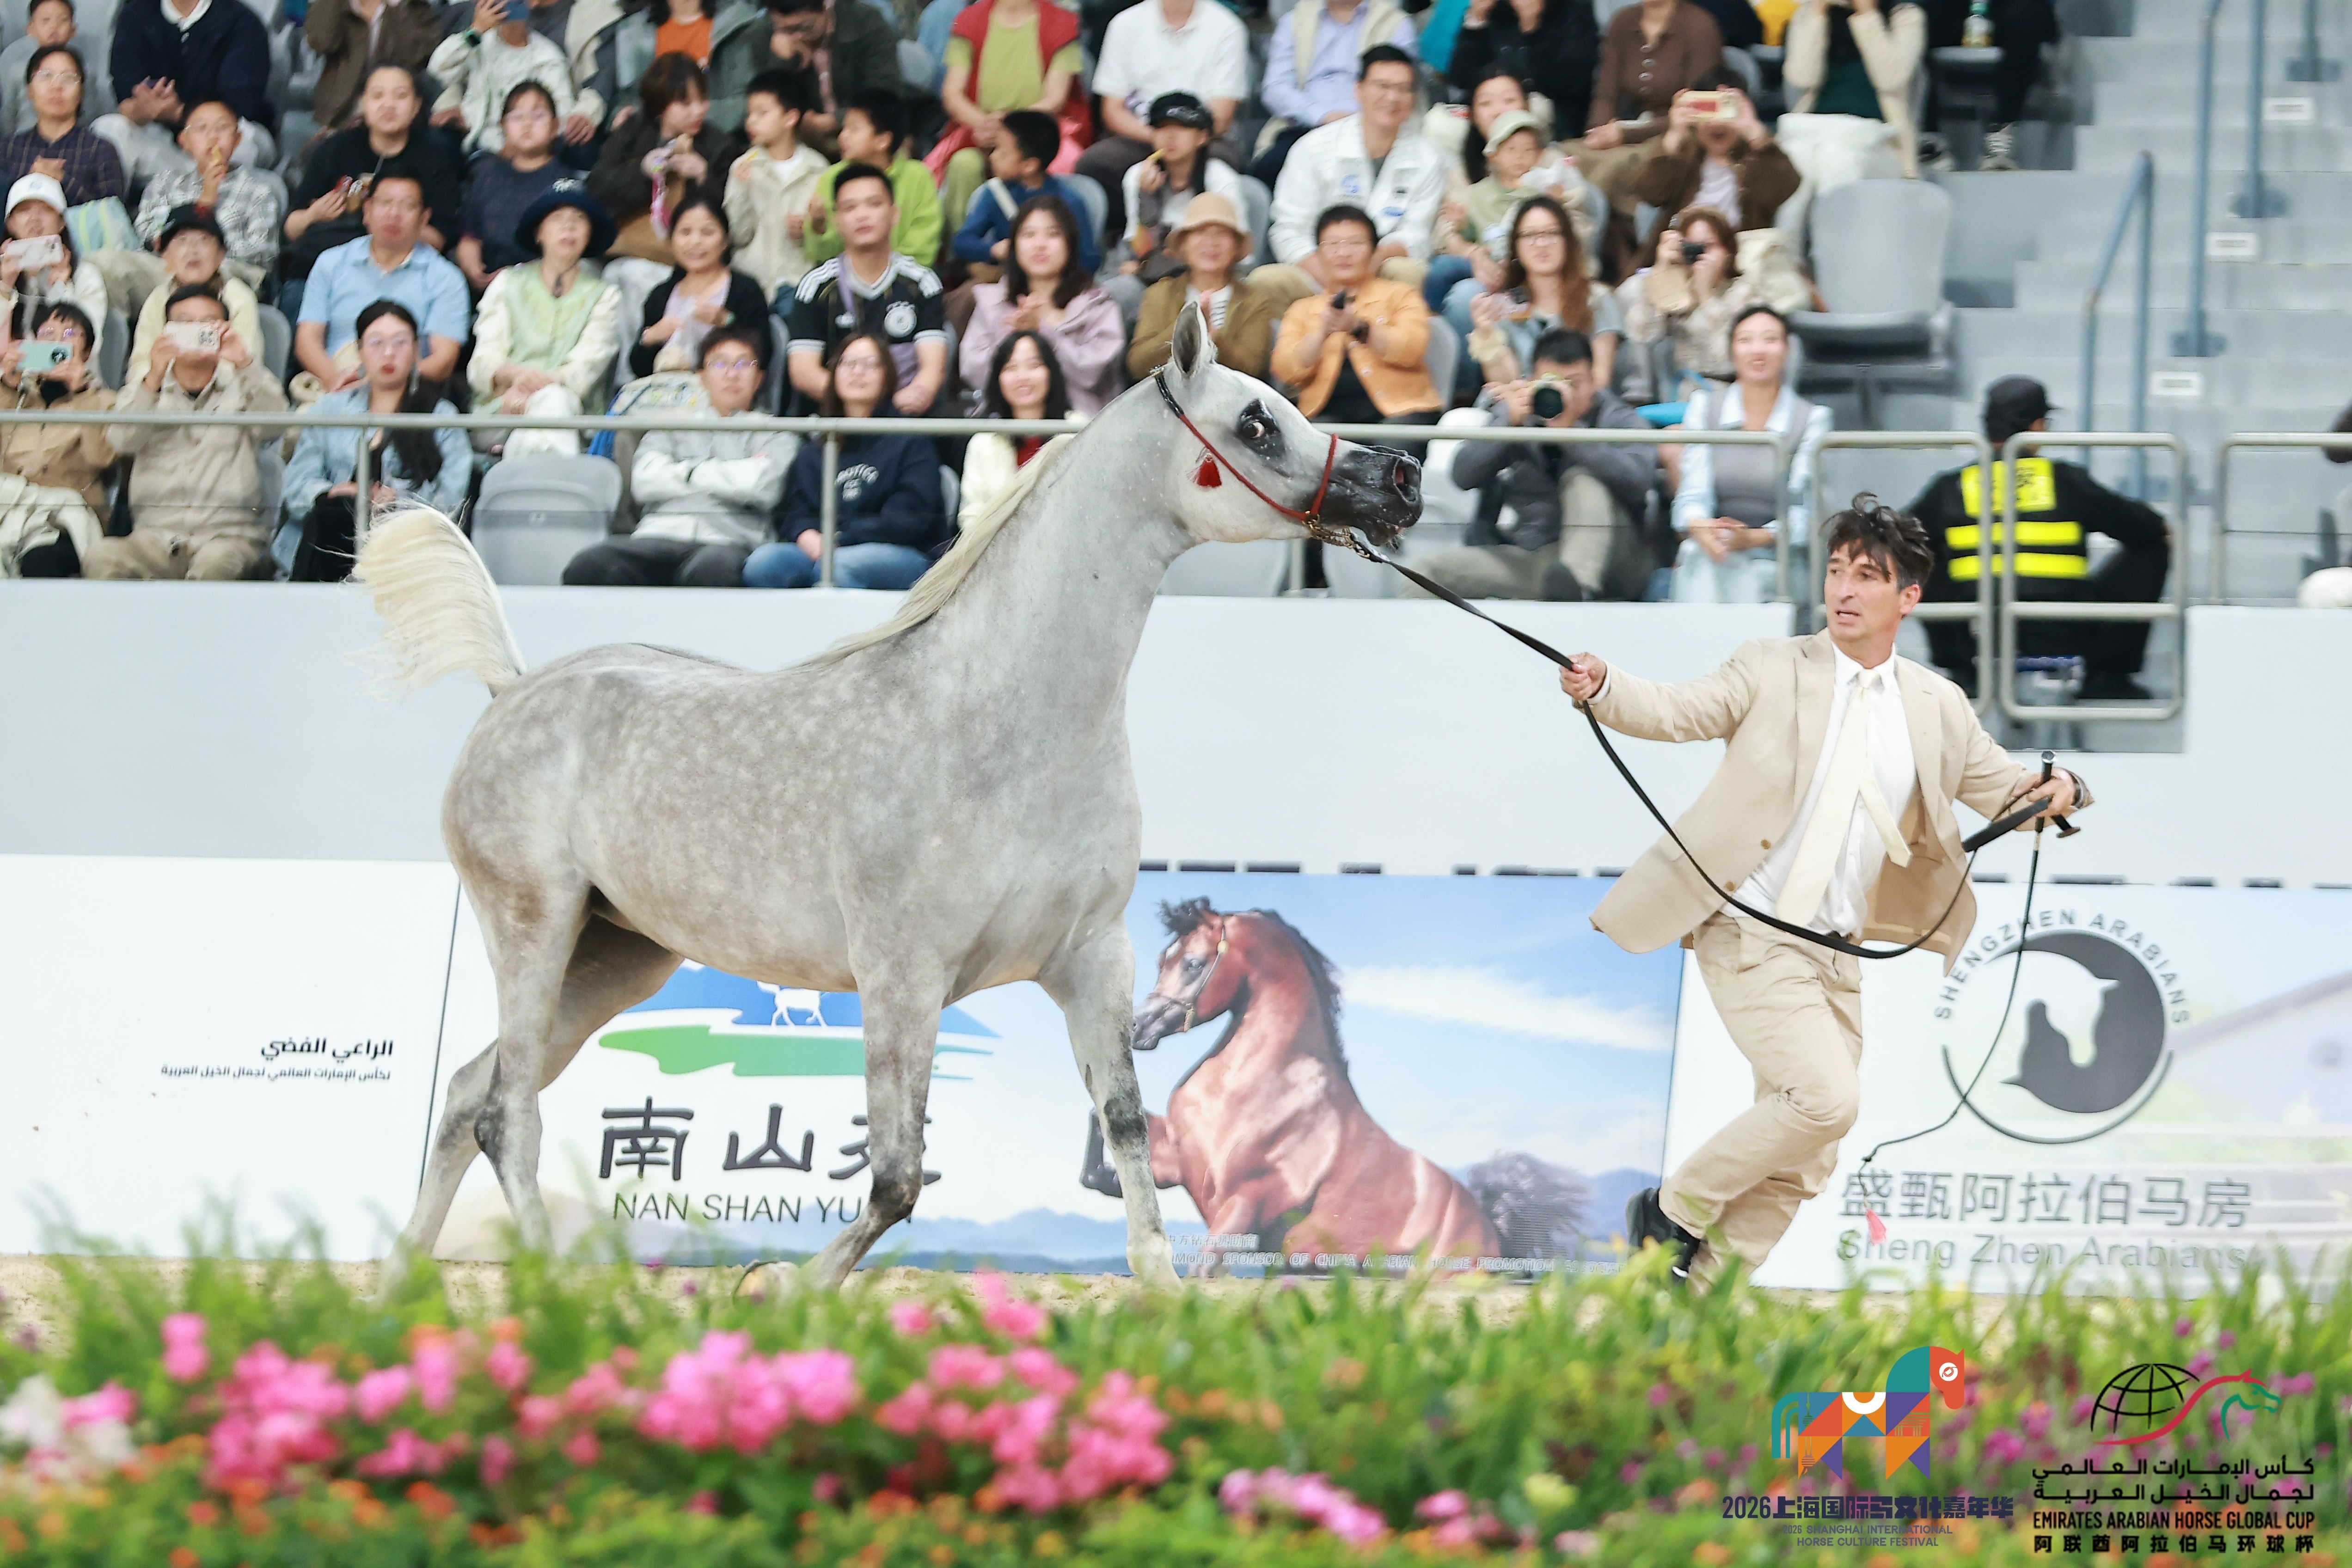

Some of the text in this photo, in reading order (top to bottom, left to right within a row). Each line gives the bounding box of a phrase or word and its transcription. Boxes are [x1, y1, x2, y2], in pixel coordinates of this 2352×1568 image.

[1935, 909, 2189, 1023] SHENGZHEN ARABIANS
[261, 1037, 393, 1063] الراعي الفضي
[599, 1096, 941, 1185] 南山
[613, 1193, 689, 1220] NAN
[702, 1194, 801, 1223] SHAN
[1838, 1168, 2252, 1227] 盛甄阿拉伯马房
[1222, 1252, 1286, 1266] SPONSOR
[1289, 1252, 1311, 1266] OF
[1476, 1256, 1556, 1271] PROMOTION
[1837, 1229, 2247, 1270] Sheng Zhen Arabians
